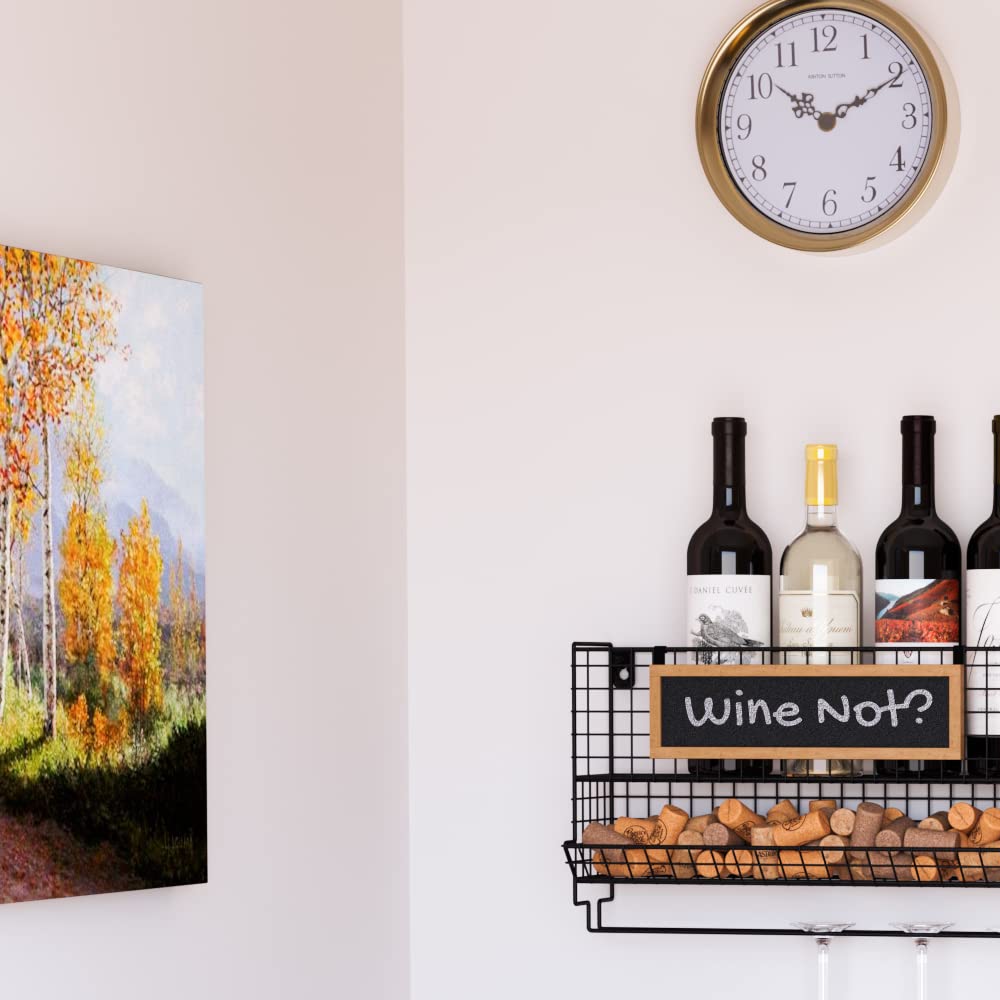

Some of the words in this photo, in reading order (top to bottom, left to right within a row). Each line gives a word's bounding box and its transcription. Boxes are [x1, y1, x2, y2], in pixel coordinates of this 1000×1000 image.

[810, 25, 838, 53] 12
[859, 34, 871, 60] 1
[774, 41, 799, 68] 11
[747, 72, 773, 100] 10
[888, 61, 904, 89] 2
[736, 113, 752, 141] 9
[901, 102, 917, 130] 3
[751, 155, 767, 182] 8
[889, 145, 906, 172] 4
[782, 182, 797, 209] 7
[822, 189, 837, 217] 6
[860, 176, 877, 203] 5
[684, 689, 802, 727] Wine
[817, 688, 933, 728] Not?
